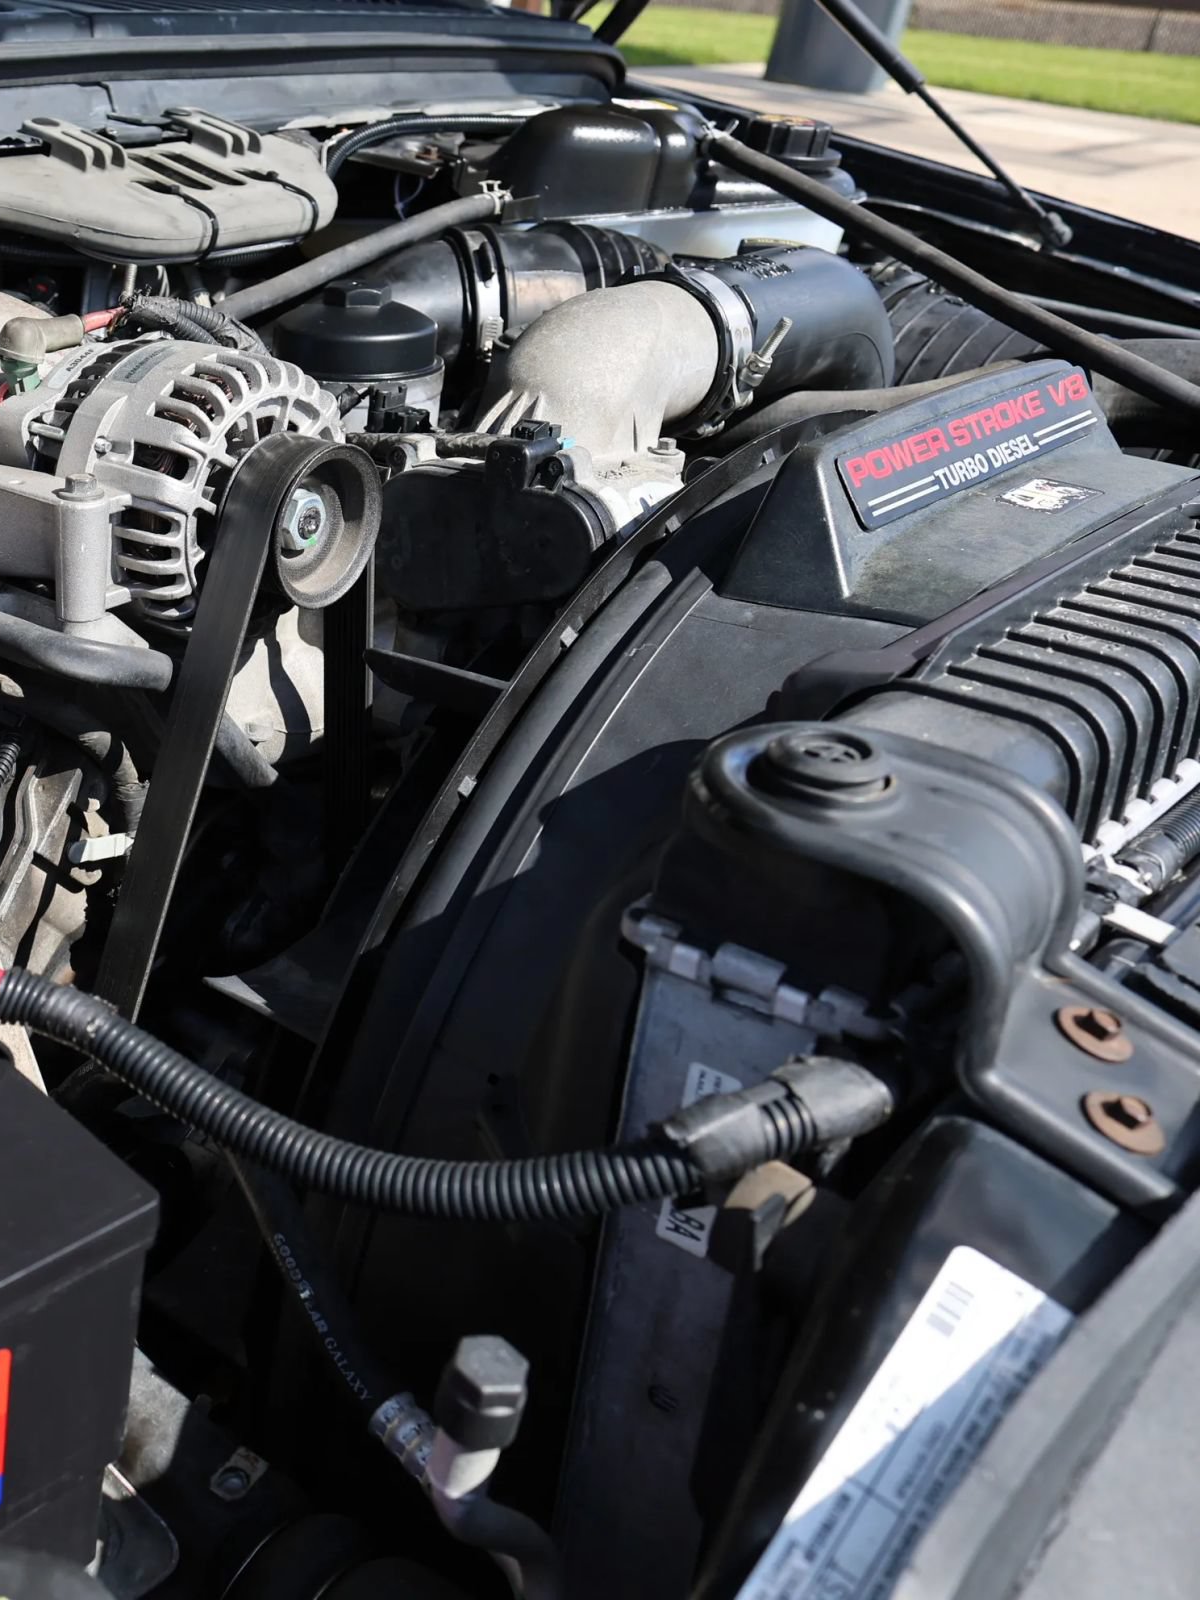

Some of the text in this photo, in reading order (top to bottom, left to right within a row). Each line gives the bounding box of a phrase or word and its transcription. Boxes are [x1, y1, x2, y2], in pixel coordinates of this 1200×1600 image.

[844, 373, 1089, 488] POWER STROKE V8
[933, 434, 1040, 490] TURBO DIESEL
[324, 1337, 372, 1401] GALAXY
